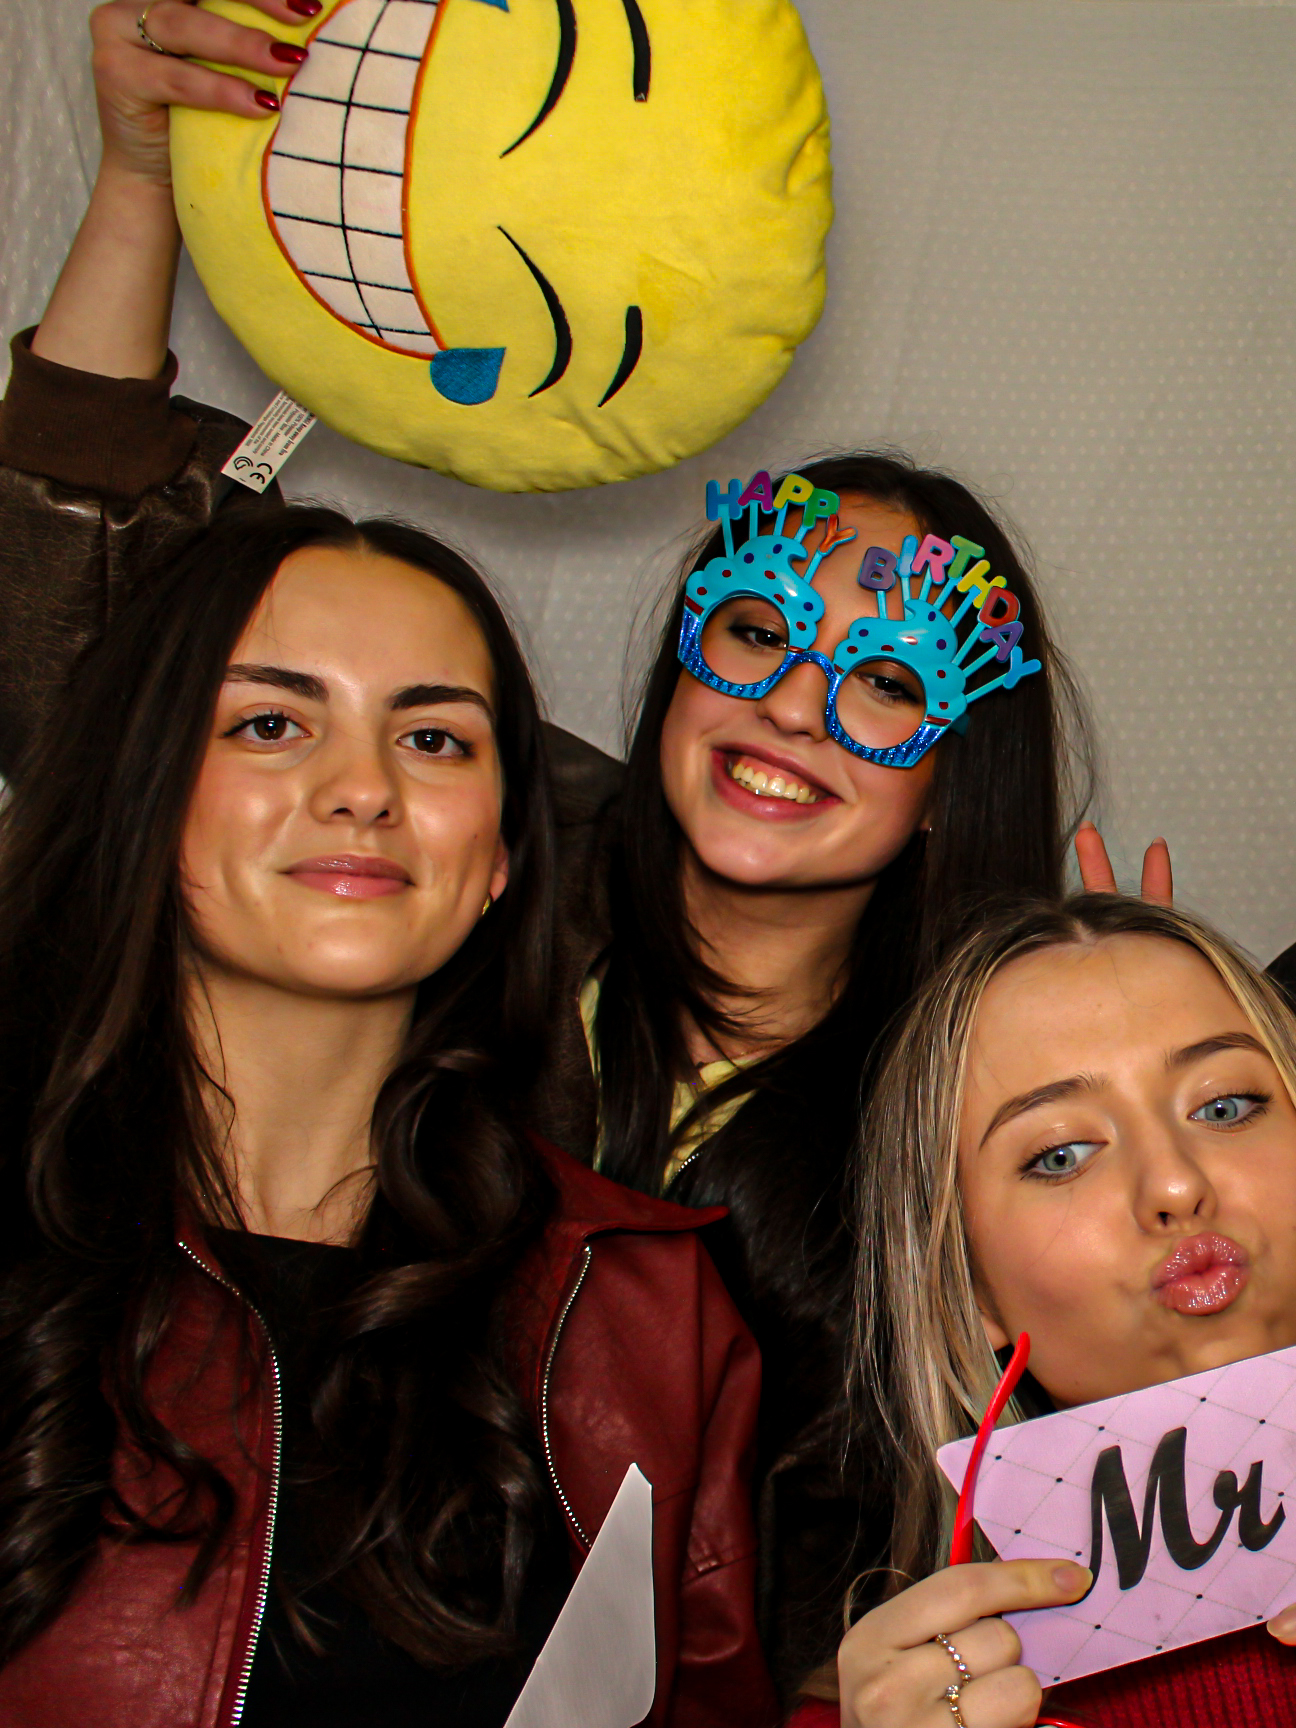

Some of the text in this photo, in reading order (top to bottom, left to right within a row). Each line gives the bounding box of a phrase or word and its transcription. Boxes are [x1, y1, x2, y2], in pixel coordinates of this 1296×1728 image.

[706, 470, 1042, 689] HAPPY BIRTHDAY
[1068, 1426, 1285, 1606] Mr
